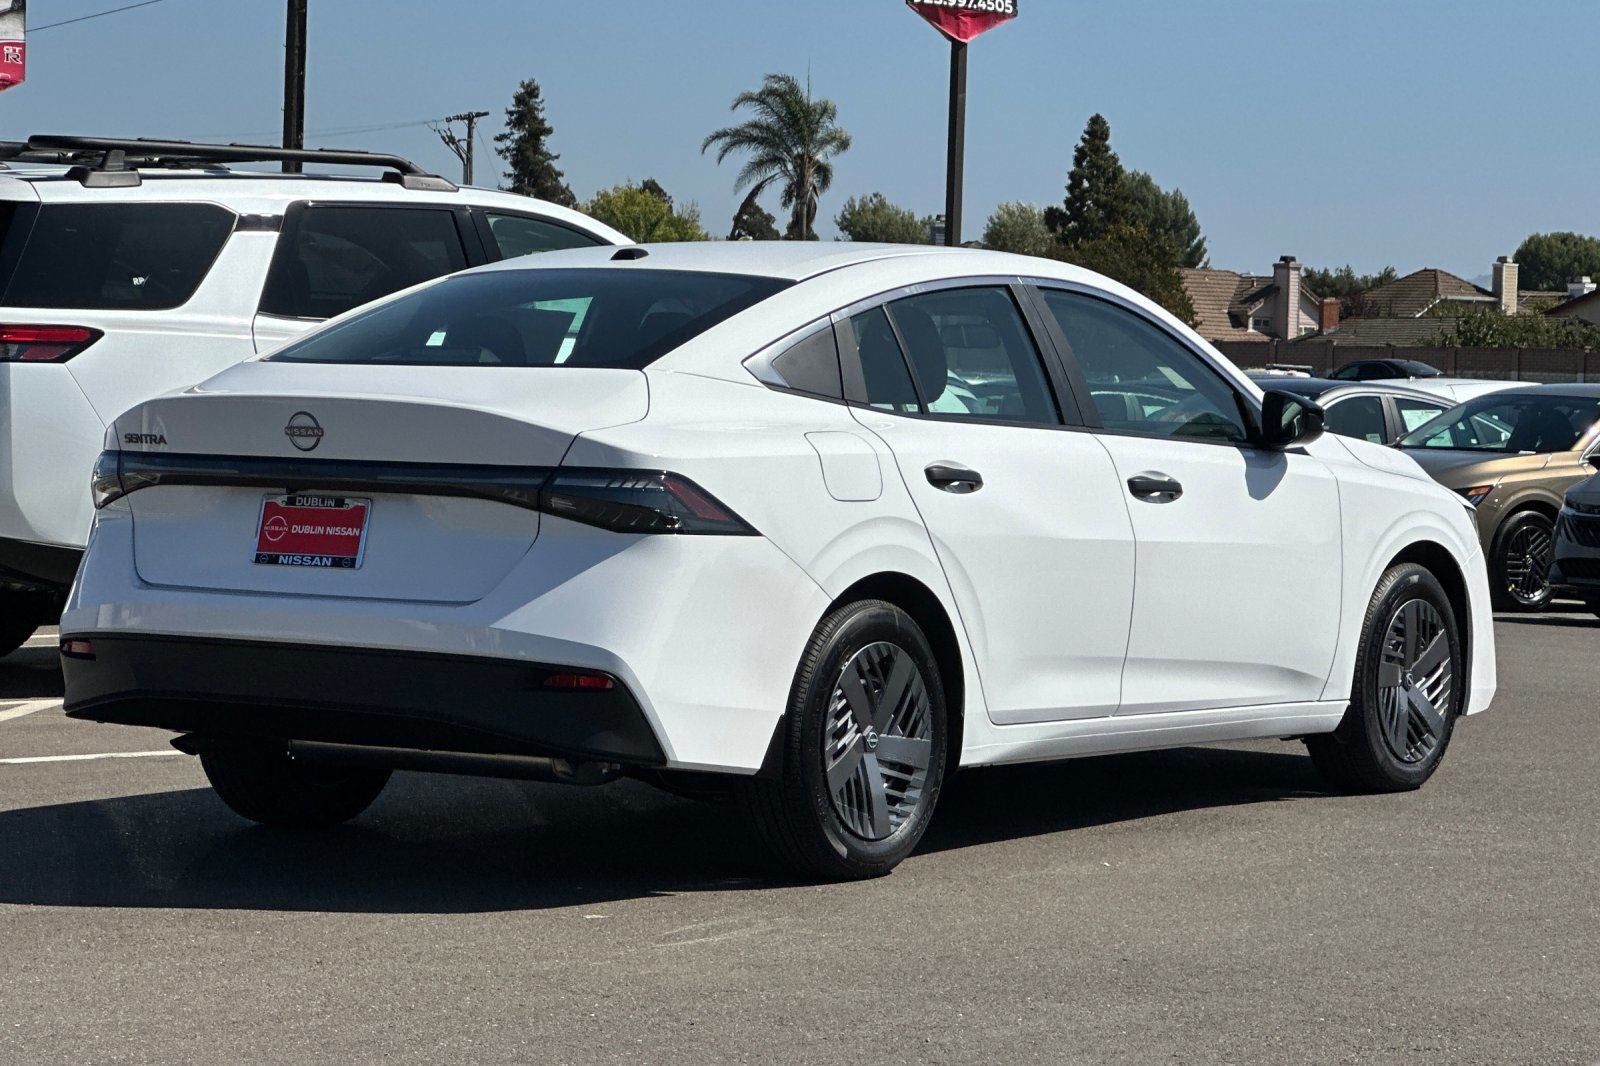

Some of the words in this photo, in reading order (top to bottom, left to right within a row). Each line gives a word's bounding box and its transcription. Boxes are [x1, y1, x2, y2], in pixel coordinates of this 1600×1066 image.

[913, 0, 1013, 13] .7.4505
[286, 426, 324, 437] NISSAN
[124, 433, 168, 445] SENTRA
[295, 496, 336, 508] DUBLIN
[291, 524, 325, 535] DUBLIN
[325, 526, 360, 537] NISSAN
[278, 555, 332, 567] NISSAN
